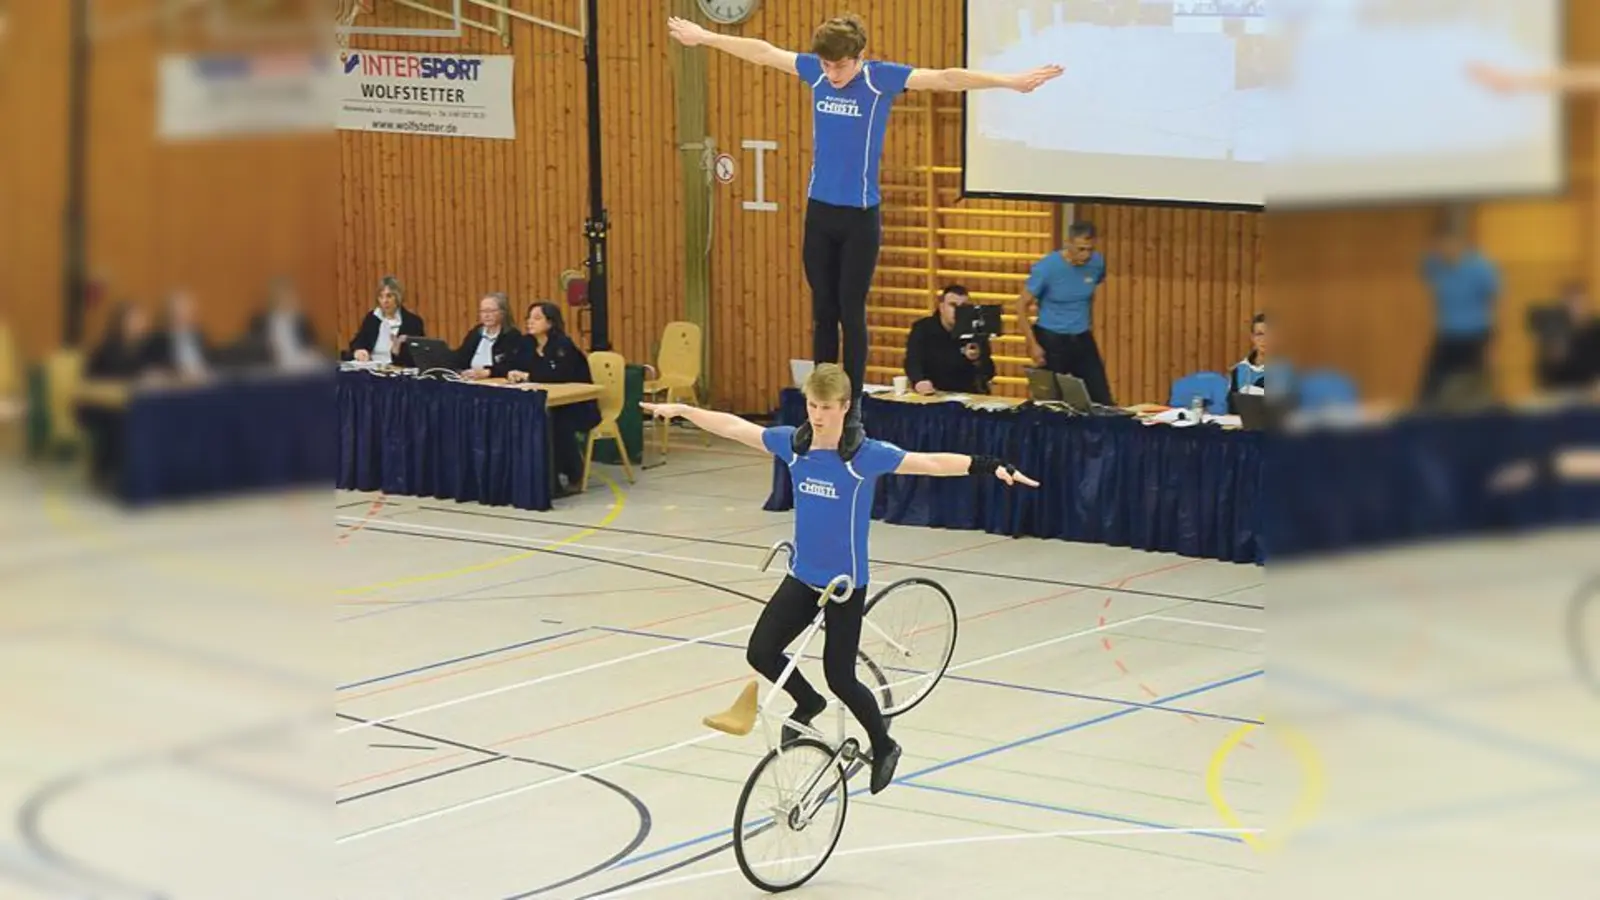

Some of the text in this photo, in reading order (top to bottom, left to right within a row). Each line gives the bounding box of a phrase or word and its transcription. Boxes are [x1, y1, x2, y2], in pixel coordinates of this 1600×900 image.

[362, 54, 481, 81] INTERSPORT
[361, 83, 465, 103] WOLFSTETTER
[372, 119, 458, 134] www.wolfstetter.de
